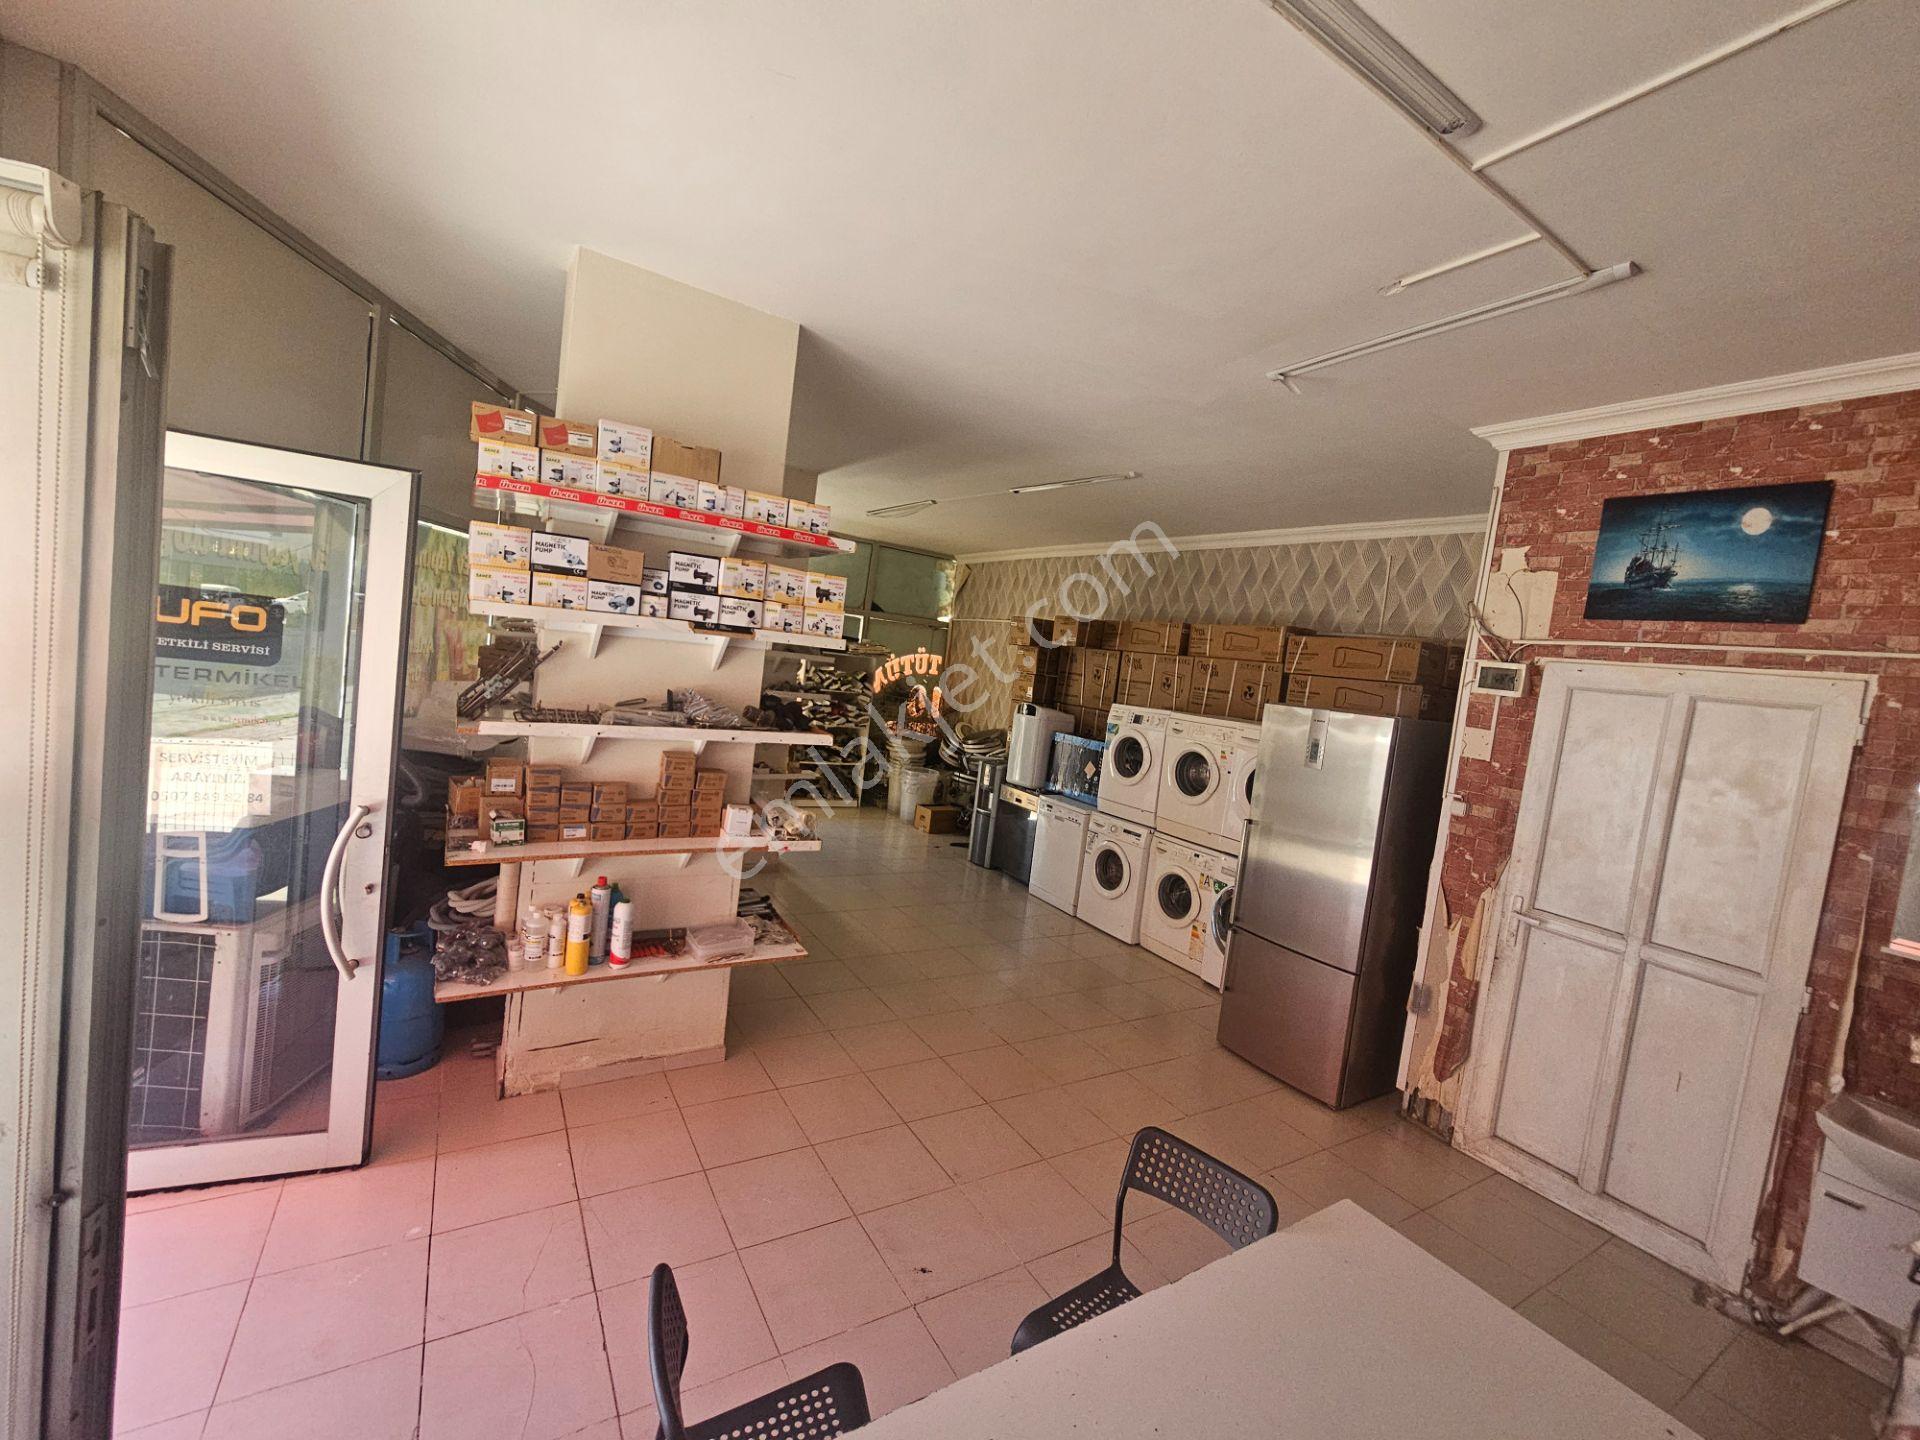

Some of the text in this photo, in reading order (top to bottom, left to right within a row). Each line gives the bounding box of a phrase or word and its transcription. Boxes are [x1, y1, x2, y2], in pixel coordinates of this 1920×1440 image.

[535, 541, 567, 551] MAGNETIC
[675, 561, 702, 569] MAGNETIC
[674, 599, 701, 607] MAGNETIC
[721, 604, 748, 613] MAGNETIC
[156, 595, 267, 633] UFO
[156, 637, 270, 656] ETKİLİ SERVİSİ
[156, 664, 302, 689] TERMİKEL
[247, 793, 263, 804] 84
